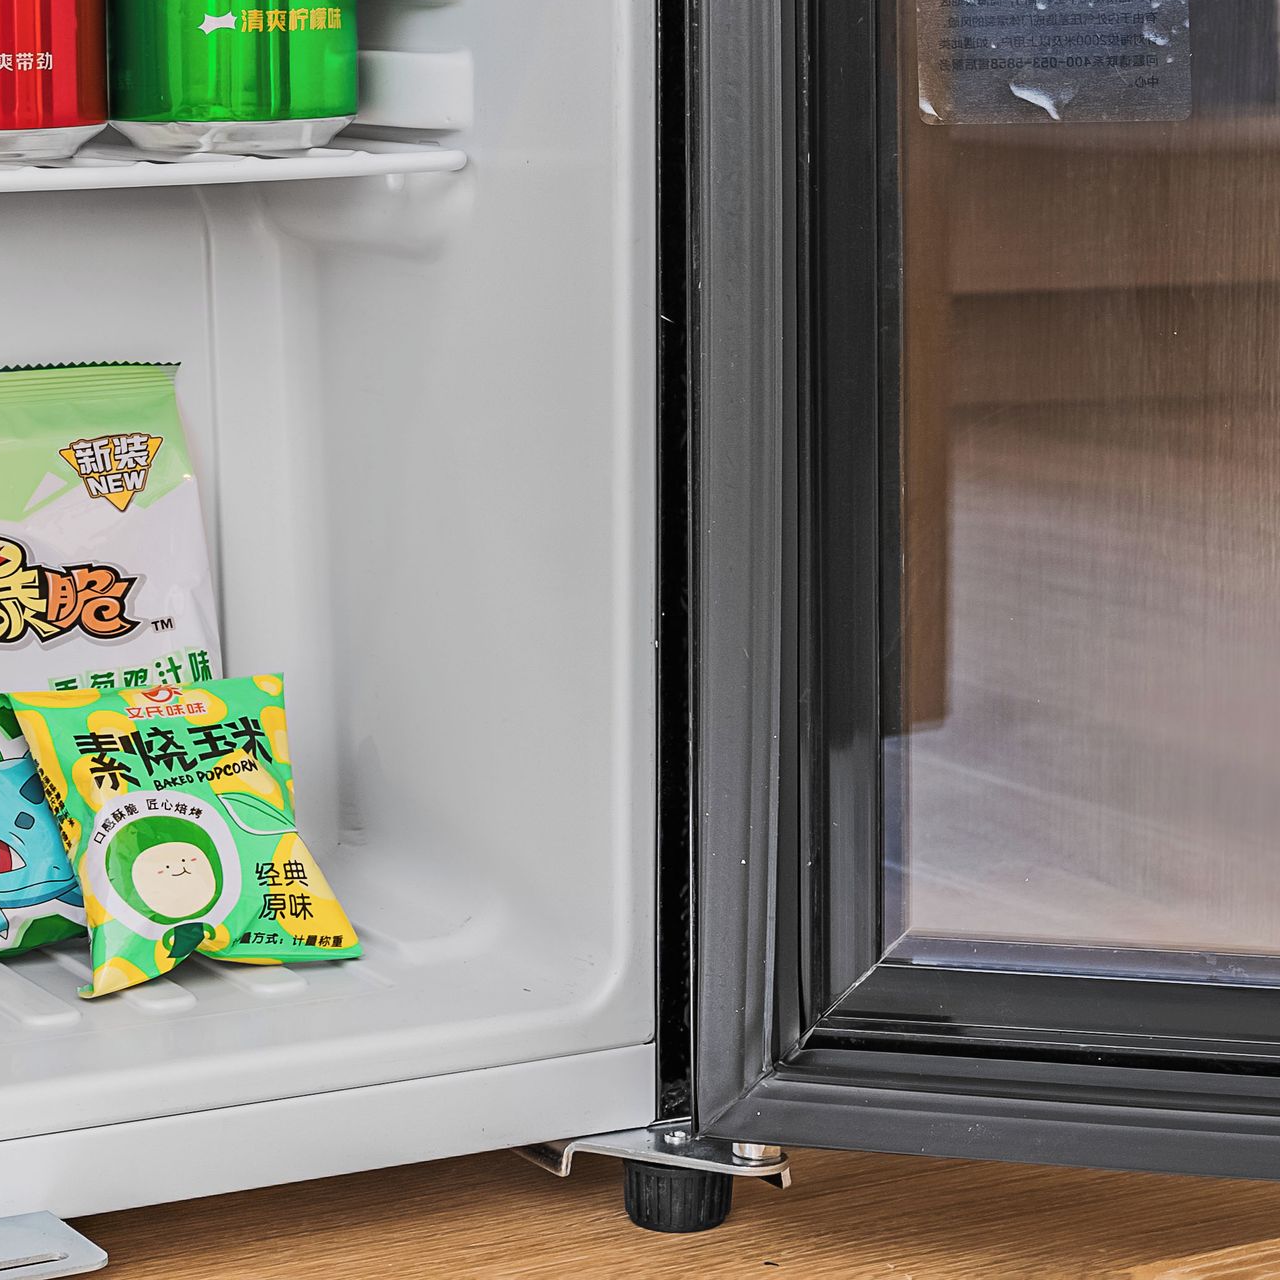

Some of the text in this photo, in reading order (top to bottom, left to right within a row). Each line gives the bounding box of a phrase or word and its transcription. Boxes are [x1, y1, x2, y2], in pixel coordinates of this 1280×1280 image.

[240, 7, 342, 33] 清爽柠檬味
[72, 435, 150, 475] 新装
[85, 469, 146, 496] NEW
[125, 702, 207, 719] 文氏味味
[72, 715, 274, 791] 素烧玉米
[153, 759, 259, 791] BAKED POPCORN
[145, 798, 204, 820] 匠心焙烤
[254, 859, 310, 888] 经典
[258, 892, 314, 921] 原味
